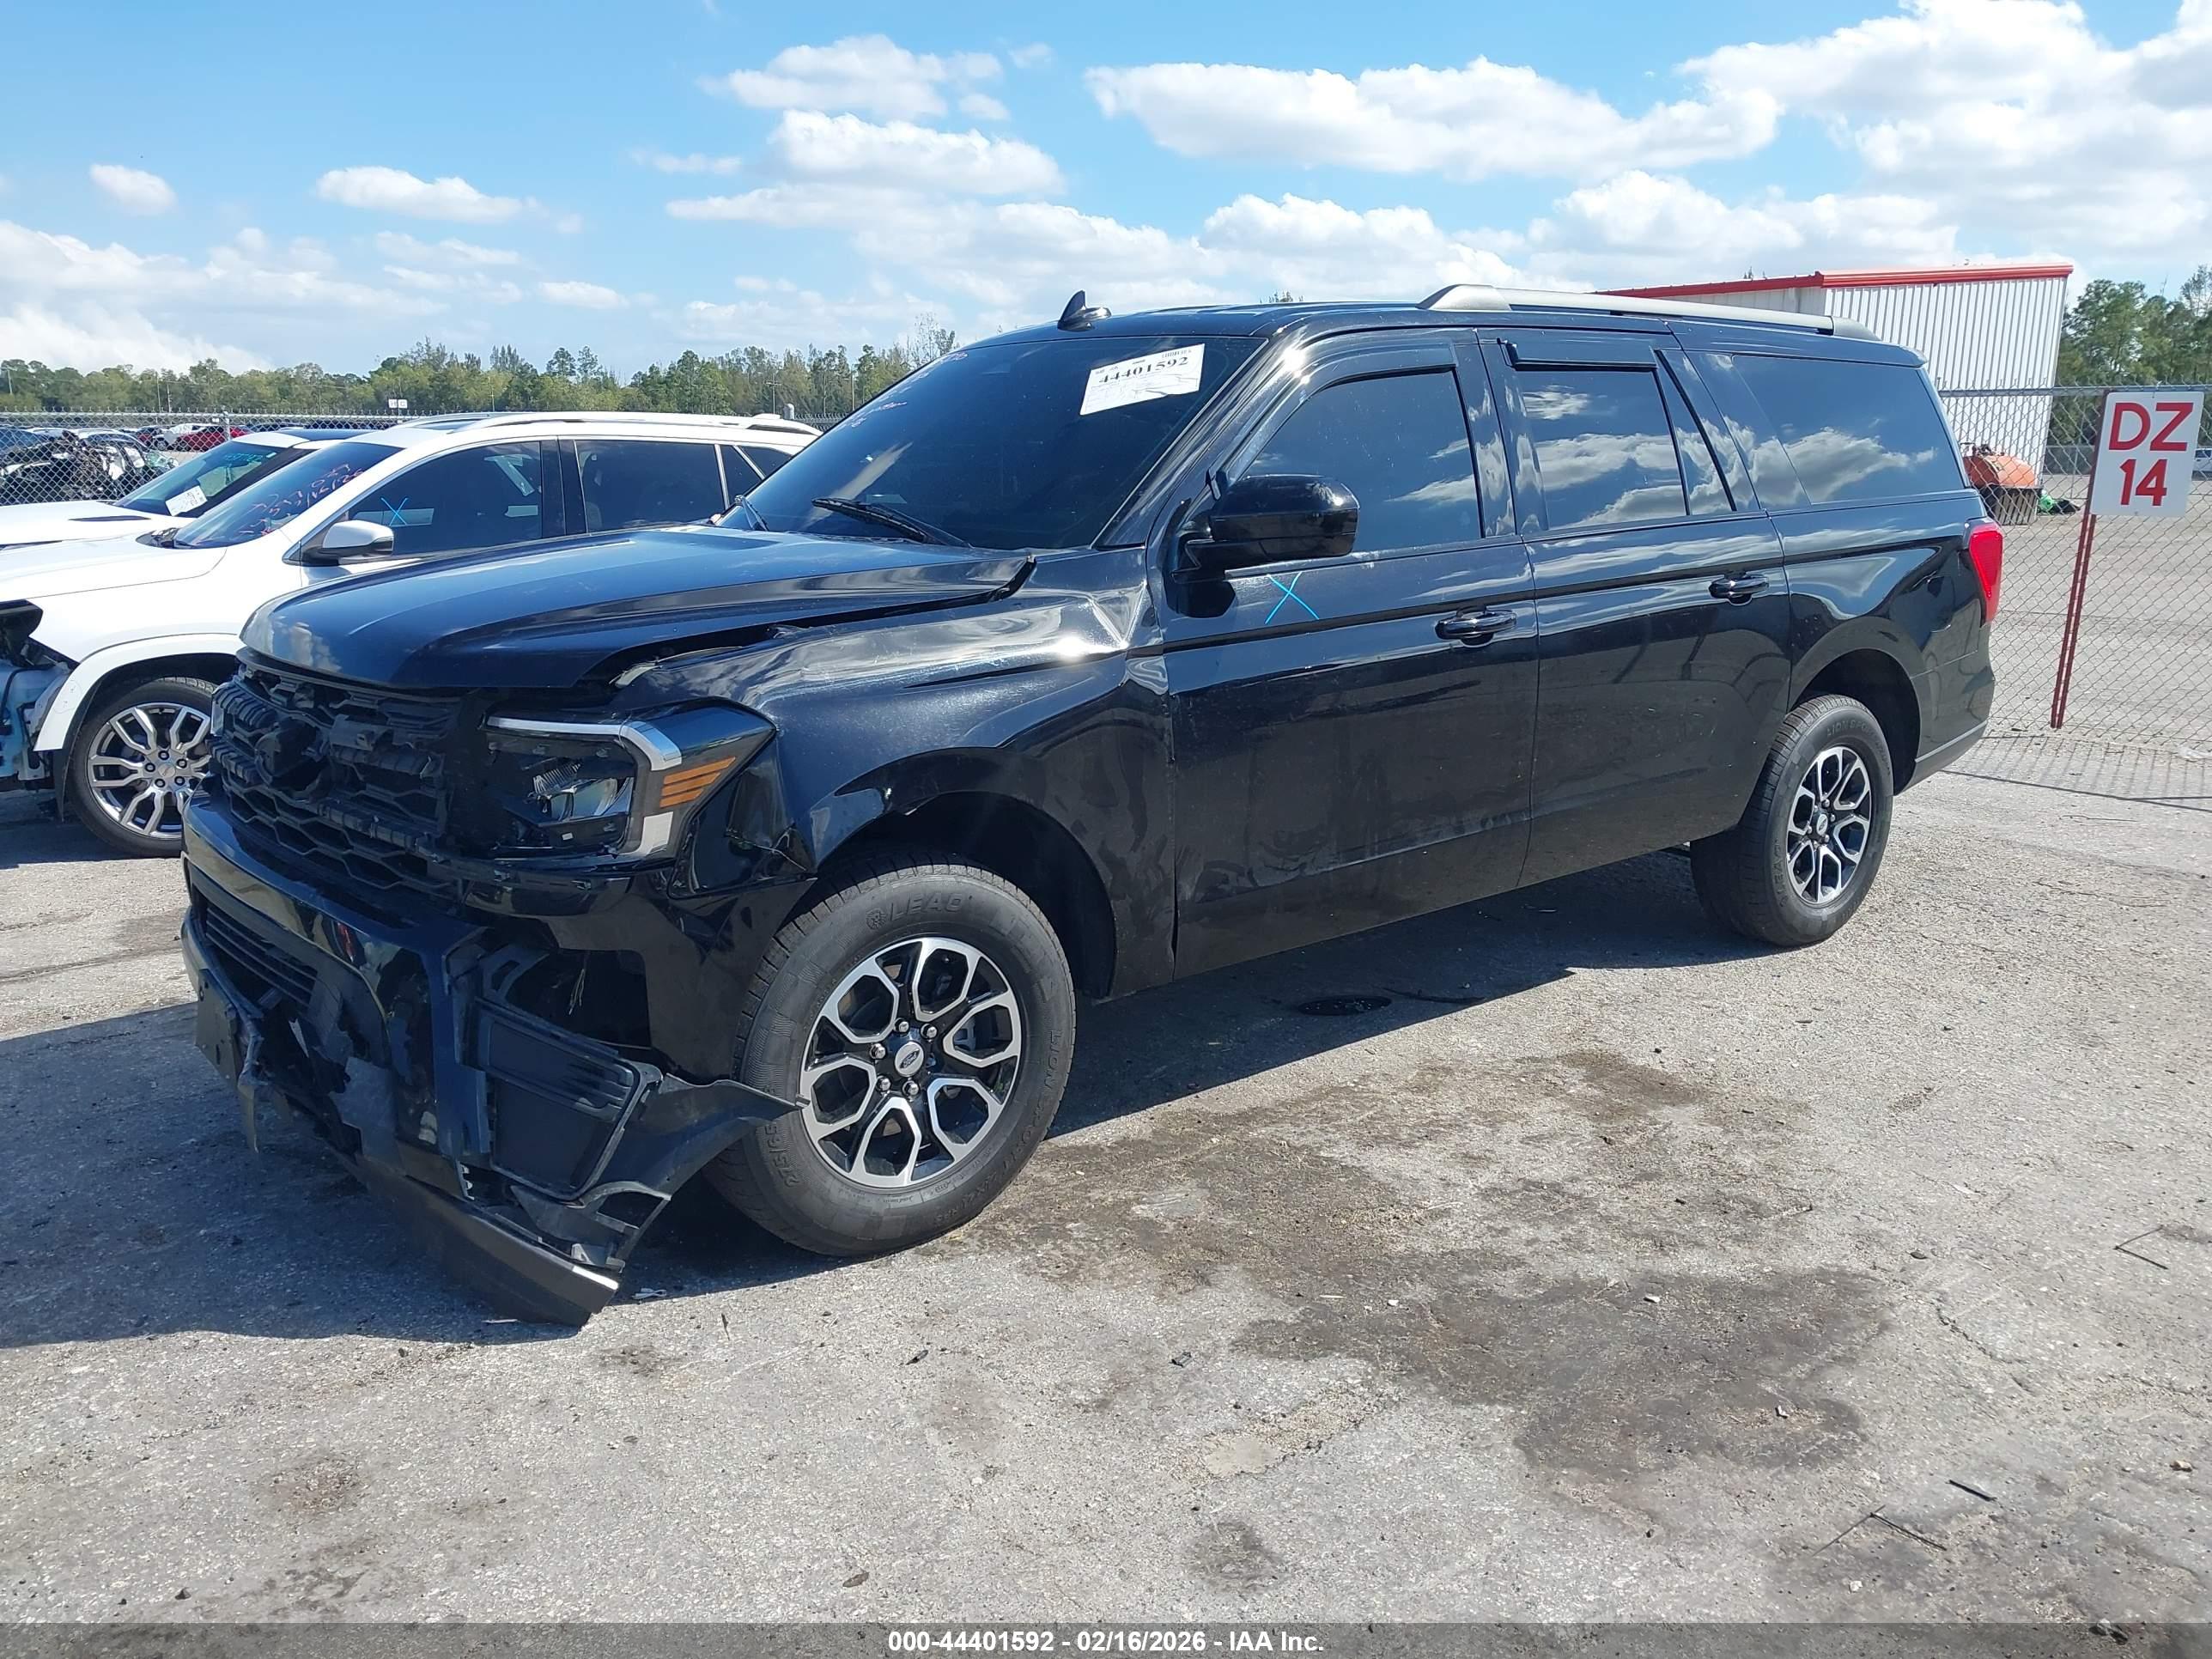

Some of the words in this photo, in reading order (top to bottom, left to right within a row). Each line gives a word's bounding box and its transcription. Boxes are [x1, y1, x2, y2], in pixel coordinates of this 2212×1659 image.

[1099, 356, 1189, 383] 44401592
[2108, 402, 2194, 452] DZ
[2119, 459, 2168, 507] 14
[890, 893, 963, 921] LEAO
[1042, 1030, 1062, 1091] LION
